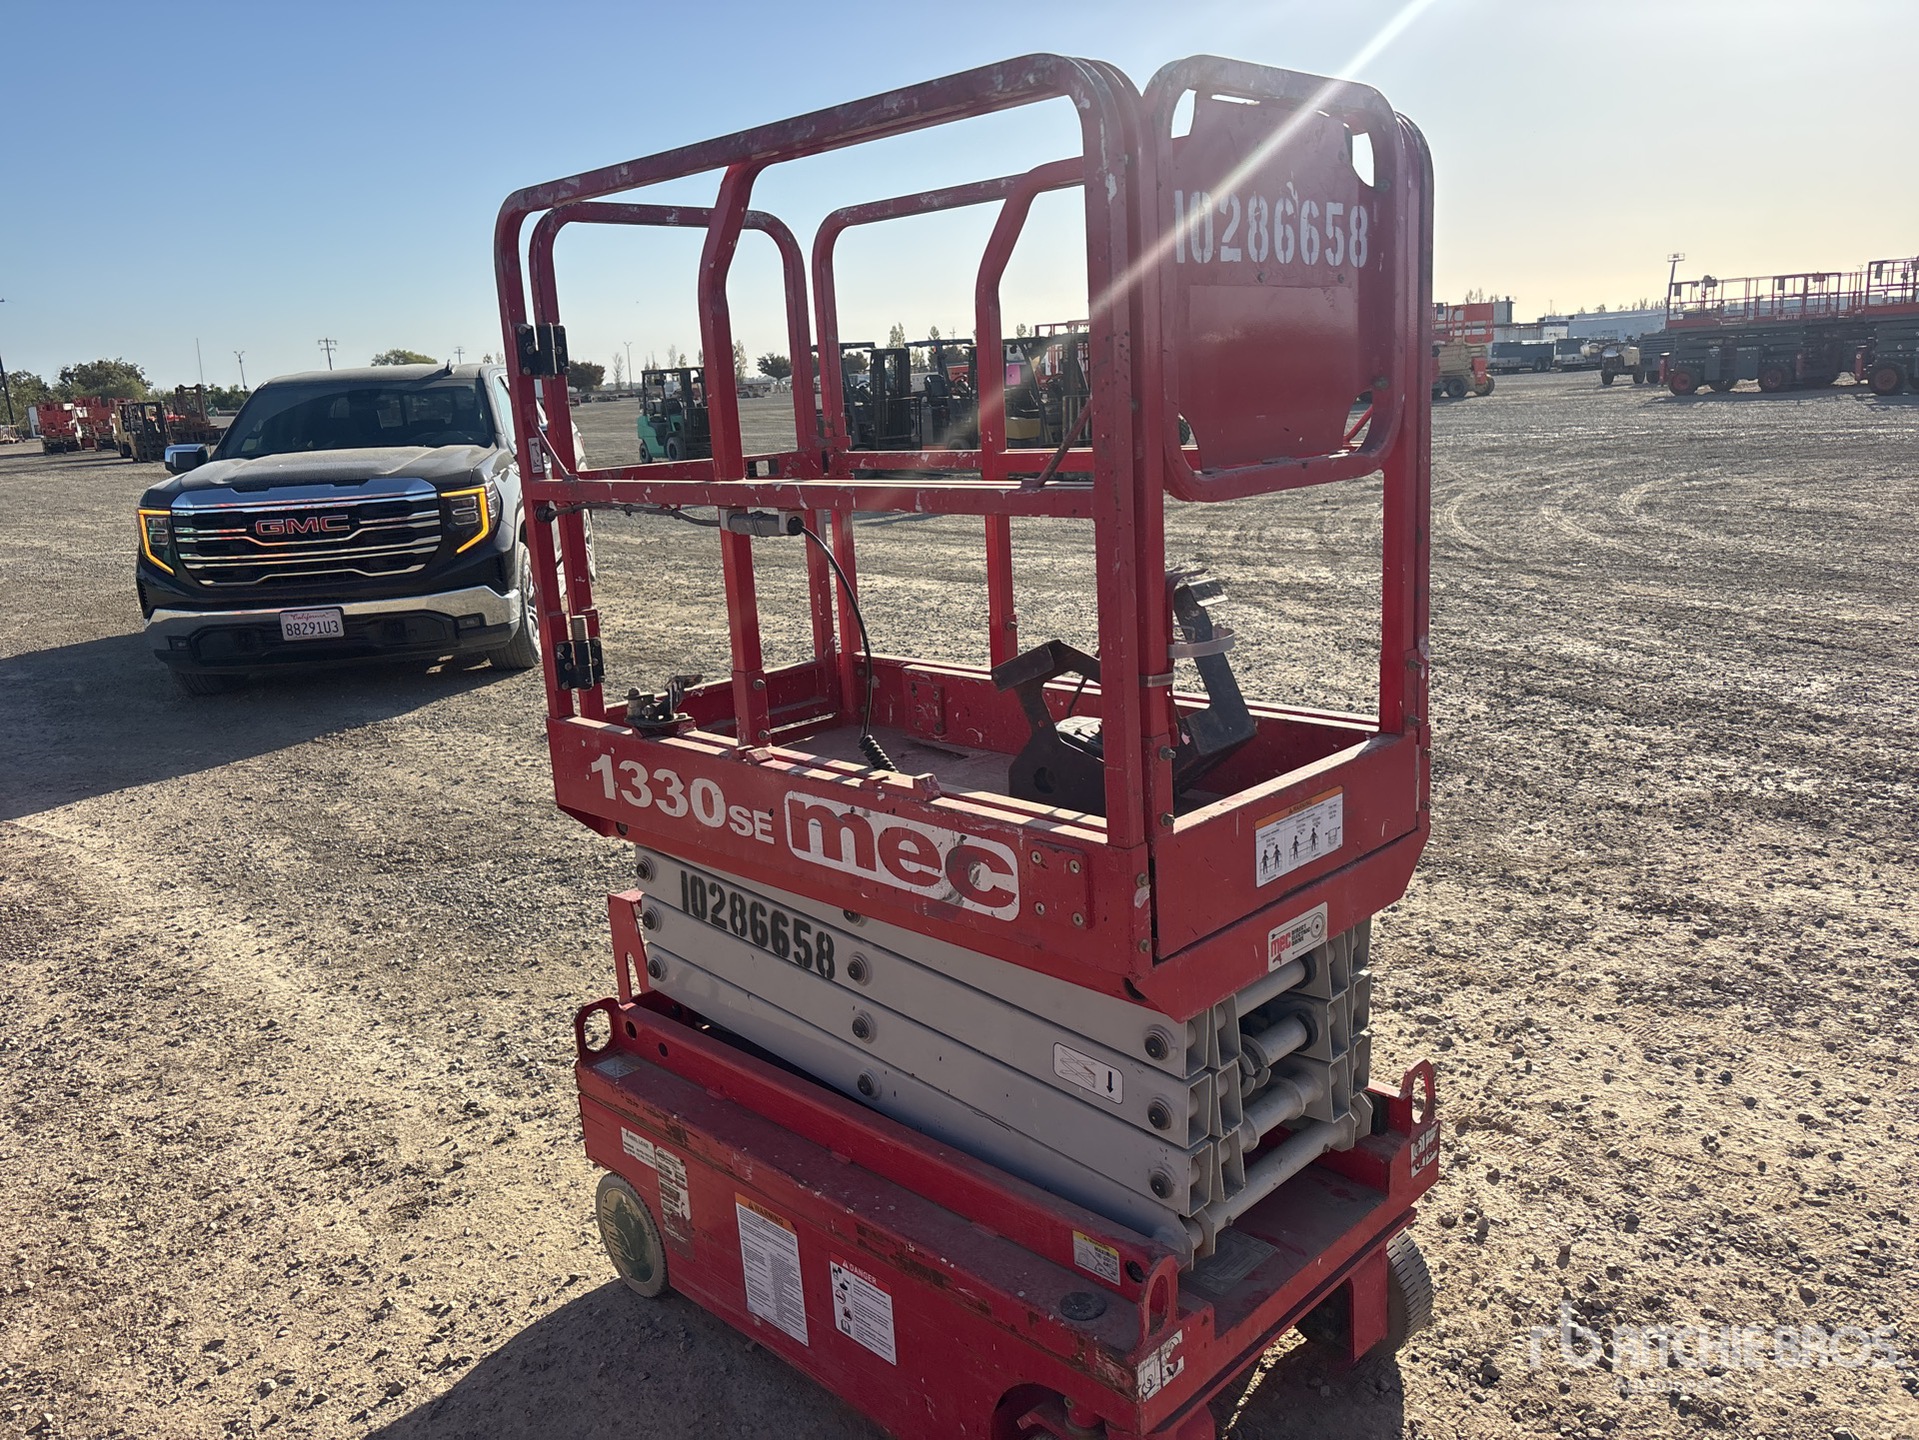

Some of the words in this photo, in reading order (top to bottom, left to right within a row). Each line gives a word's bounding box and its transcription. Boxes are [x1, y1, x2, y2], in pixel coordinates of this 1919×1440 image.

[1174, 189, 1368, 268] 10286658
[255, 514, 350, 536] GMC
[285, 620, 339, 637] 88291U3
[791, 797, 1019, 910] mec
[680, 870, 836, 980] 10286658
[849, 1263, 878, 1286] DANGER
